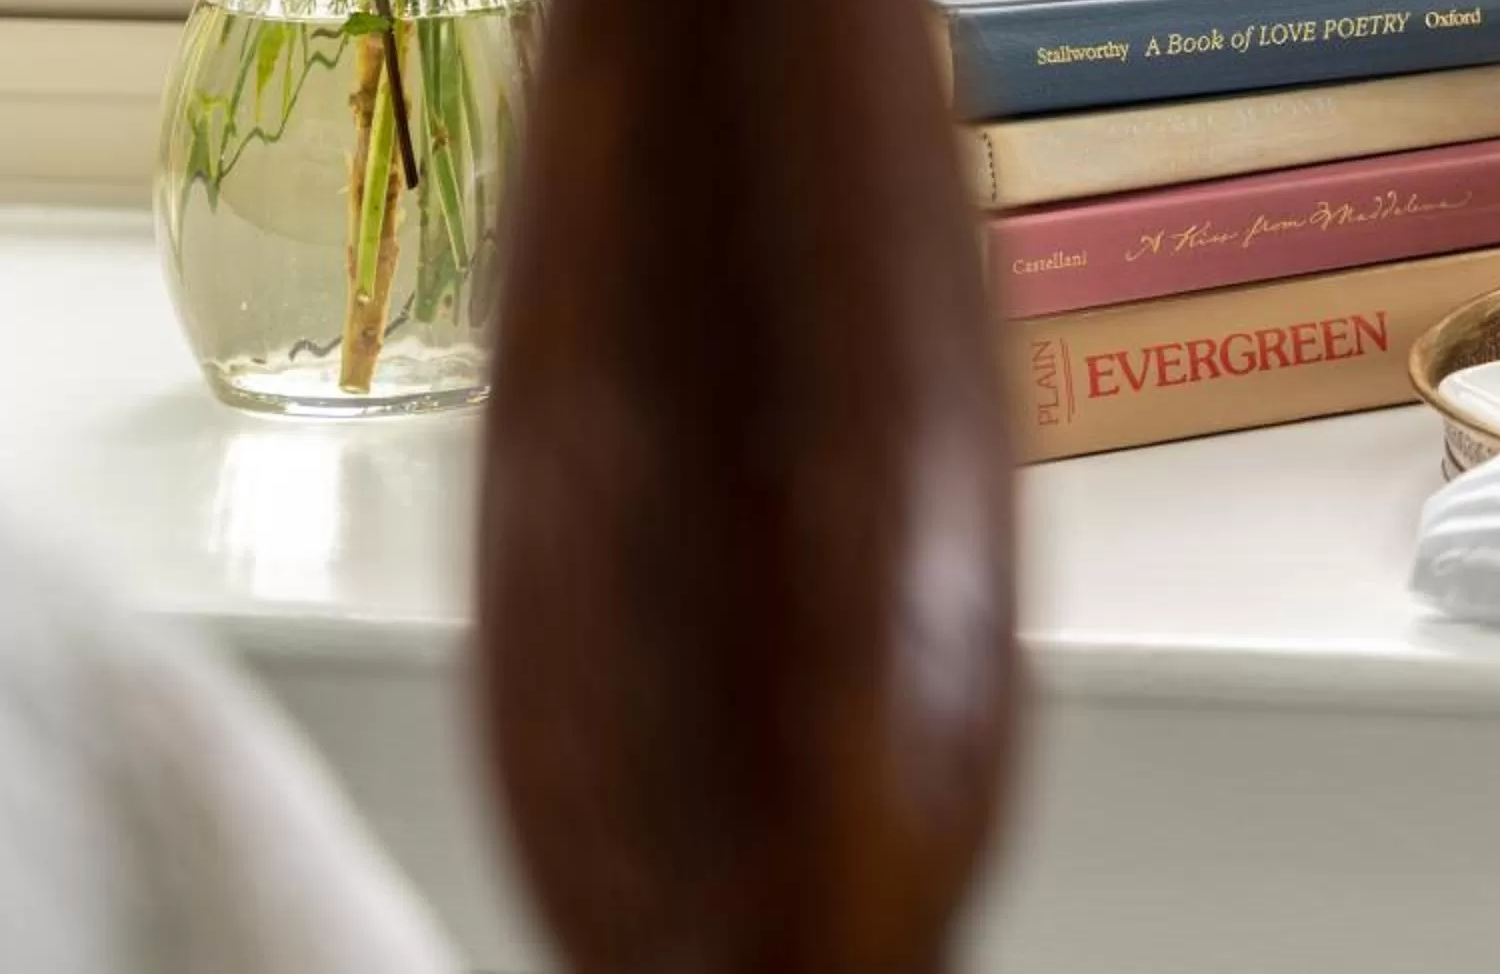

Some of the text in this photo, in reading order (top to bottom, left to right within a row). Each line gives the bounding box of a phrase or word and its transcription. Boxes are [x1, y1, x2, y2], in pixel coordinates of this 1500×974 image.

[1037, 8, 1481, 65] Stallworthy A Book of LOVE POETRY Oxford
[1012, 249, 1088, 276] Castellani
[1241, 214, 1306, 248] from
[1031, 339, 1060, 426] PLAIN
[1085, 310, 1390, 399] EVERGREEN
